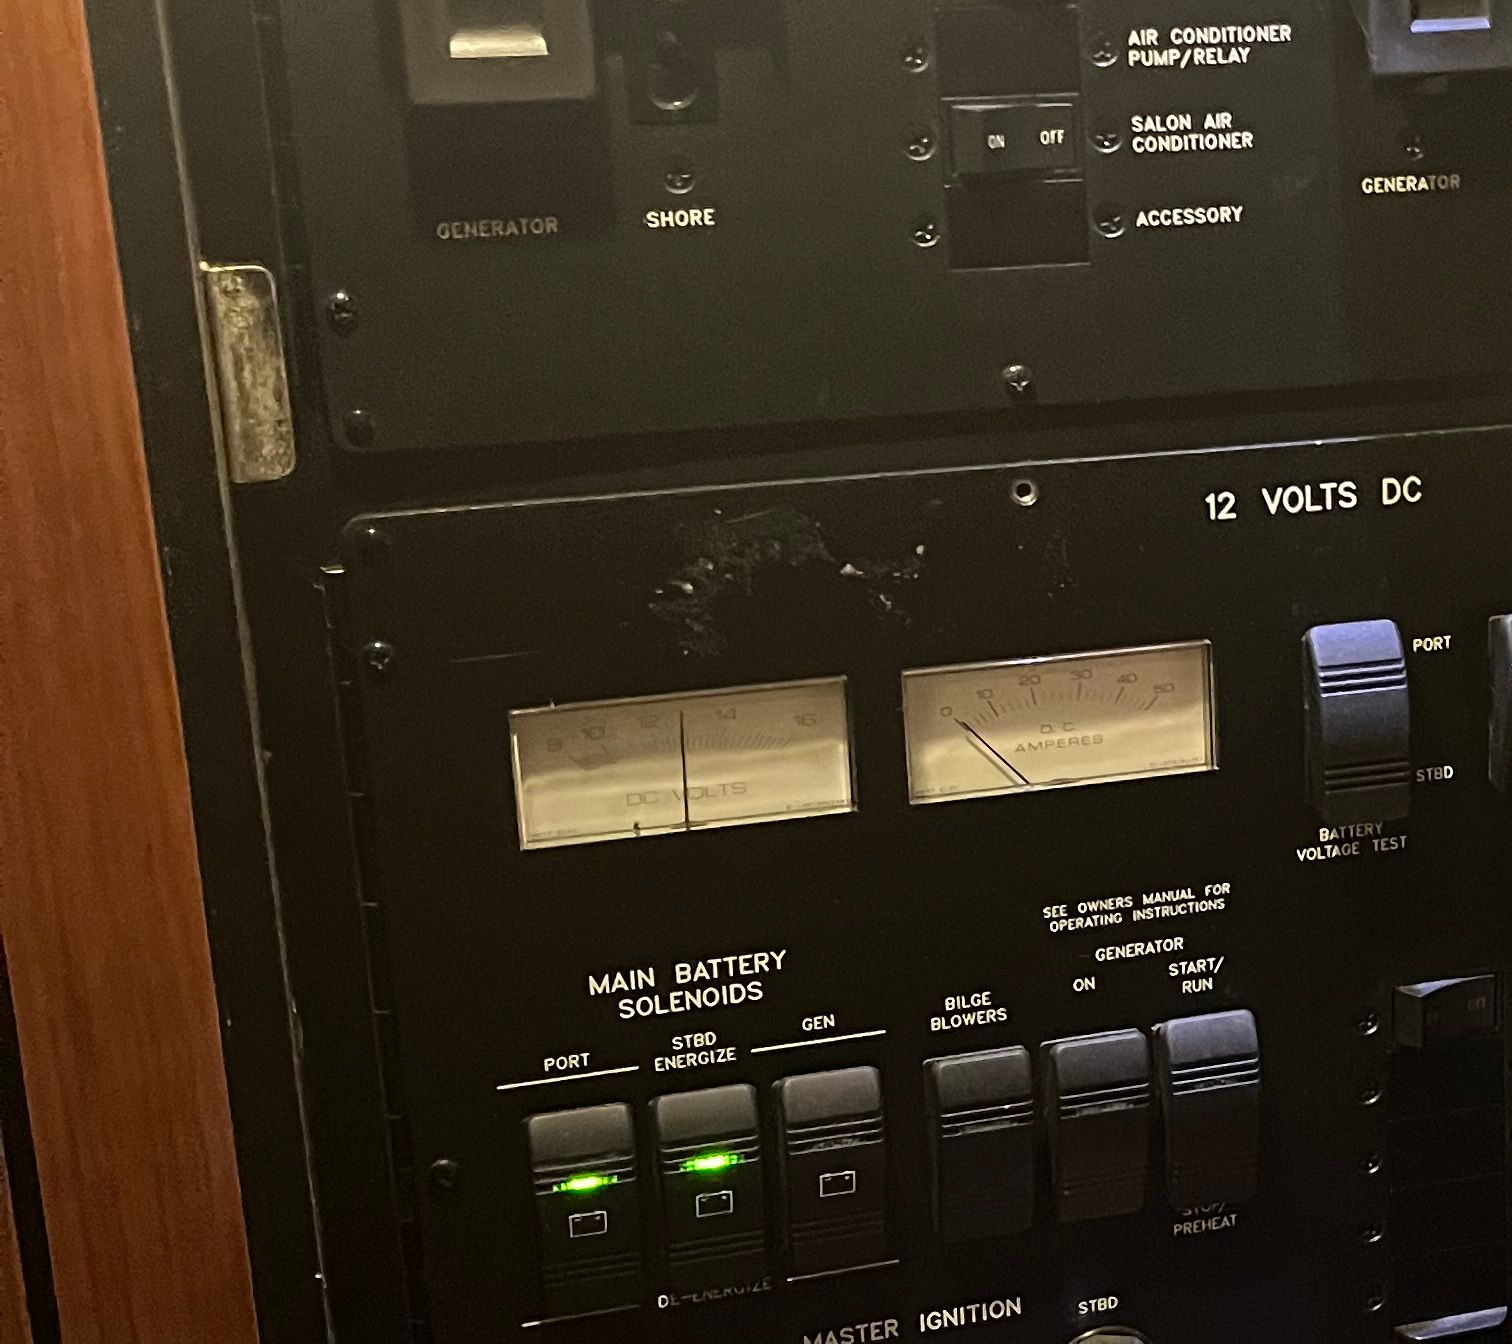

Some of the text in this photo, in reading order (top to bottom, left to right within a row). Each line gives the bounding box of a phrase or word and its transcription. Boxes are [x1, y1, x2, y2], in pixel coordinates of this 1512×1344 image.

[1129, 25, 1291, 46] AIR CONDITIONER
[1129, 47, 1250, 68] PUMP/RELAY
[1132, 112, 1232, 132] SALON AIR
[1133, 132, 1253, 153] CONDITIONER
[1362, 174, 1461, 194] GENERATOR
[647, 209, 715, 227] SHORE
[1137, 206, 1242, 226] ACCESSORY
[437, 217, 557, 239] GENERATOR
[1205, 476, 1421, 520] 12 VOLTS DC
[1413, 635, 1451, 651] PORT
[1416, 765, 1454, 780] STBD
[1320, 821, 1384, 843] BATTERY
[1296, 836, 1406, 862] VOLTAGE TEST
[1043, 883, 1230, 918] SEE OWNERS MANUAL FOR
[1050, 898, 1225, 932] OPERATING INSTRUCTIONS
[1095, 937, 1183, 961] GENERATOR
[589, 950, 785, 995] MAIN BATTERY
[1169, 957, 1224, 976] START/
[1073, 977, 1095, 991] ON
[1183, 978, 1212, 993] RUN
[618, 981, 764, 1019] SOLENOIDS
[945, 992, 991, 1010] BILGE
[802, 1014, 834, 1031] GEN
[931, 1008, 1007, 1031] BLOWERS
[672, 1032, 716, 1050] STBD
[544, 1053, 589, 1071] PORT
[655, 1047, 736, 1071] ENERGIZE
[1174, 1214, 1236, 1235] PREHEAT
[920, 1298, 1021, 1332] IGNITION
[1079, 1297, 1118, 1314] STBD
